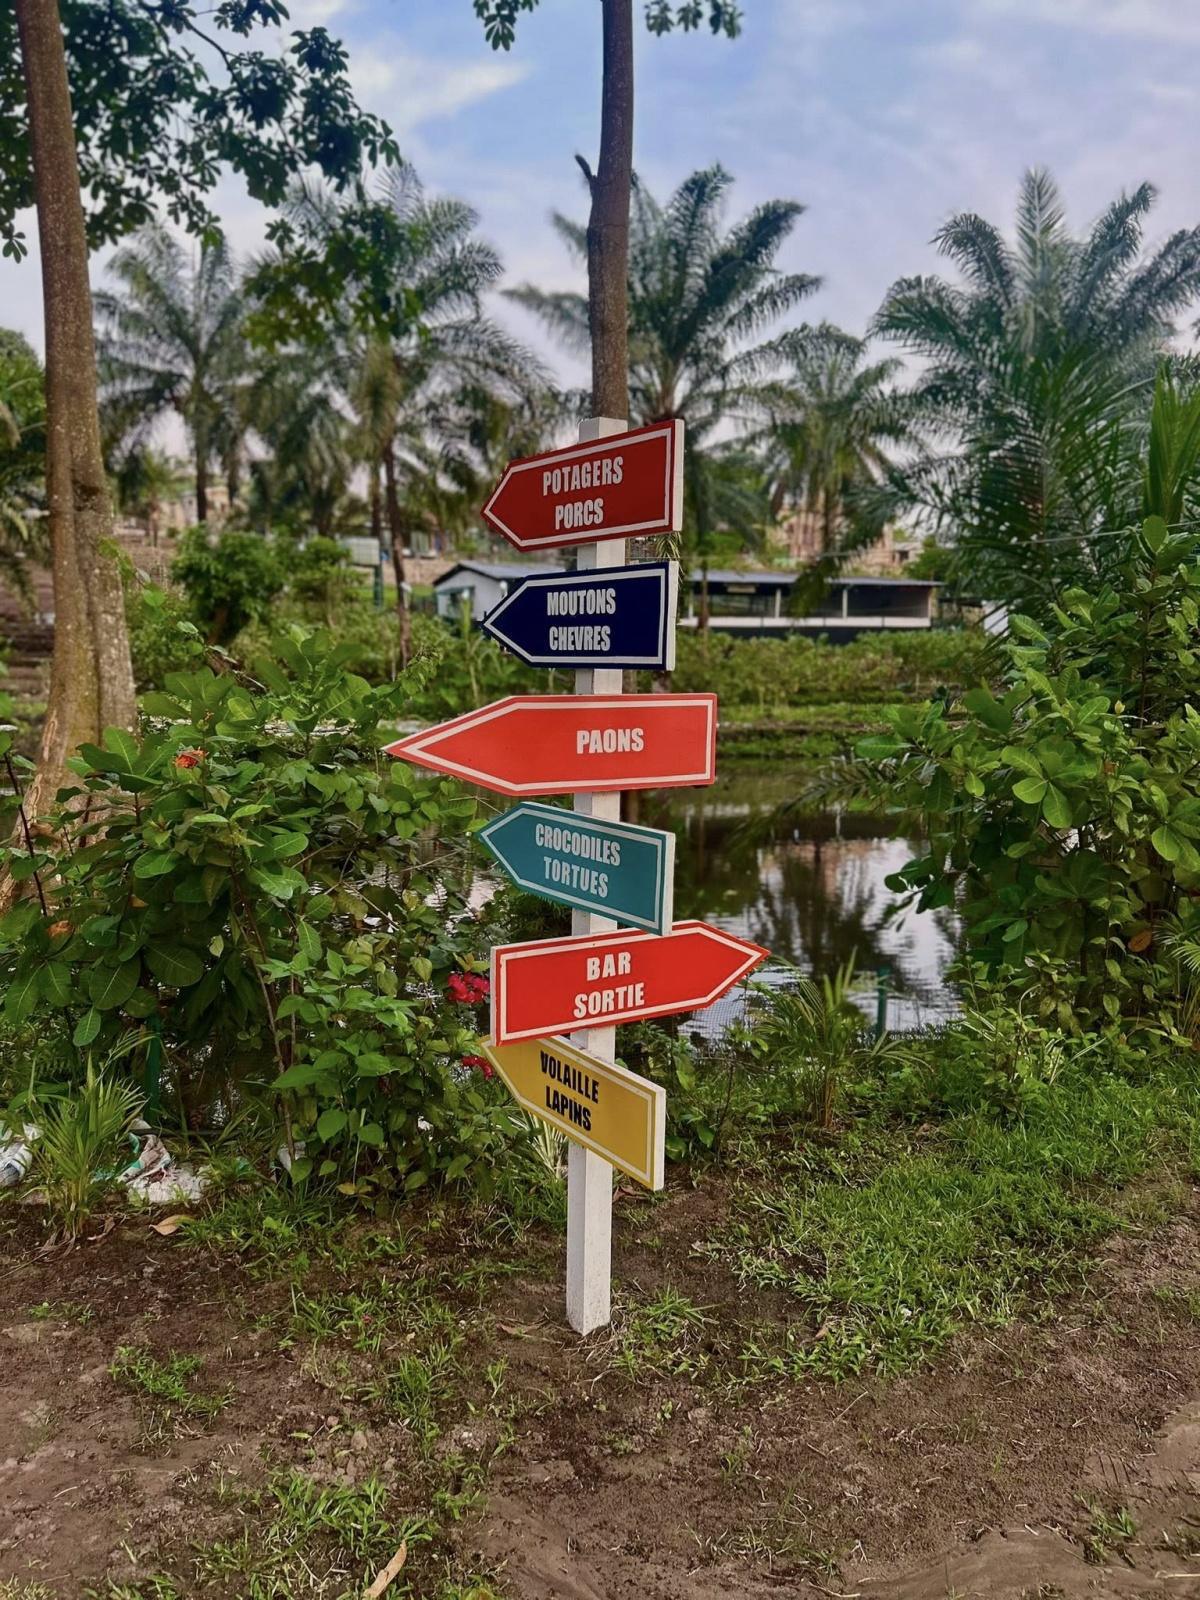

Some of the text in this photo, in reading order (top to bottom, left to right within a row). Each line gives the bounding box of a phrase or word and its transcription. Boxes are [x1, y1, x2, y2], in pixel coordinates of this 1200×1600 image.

[543, 456, 624, 496] POTAGERS
[555, 498, 604, 530] PORCS
[547, 588, 616, 616] MOUTONS
[549, 625, 611, 651] CHEVRES
[576, 728, 644, 754] PAONS
[535, 823, 621, 866] CROCODILES
[544, 856, 609, 898] TORTUES
[586, 951, 631, 981] BAR
[573, 982, 644, 1019] SORTIE
[540, 1050, 600, 1104] VOLAILLE
[546, 1085, 591, 1131] LAPINS
